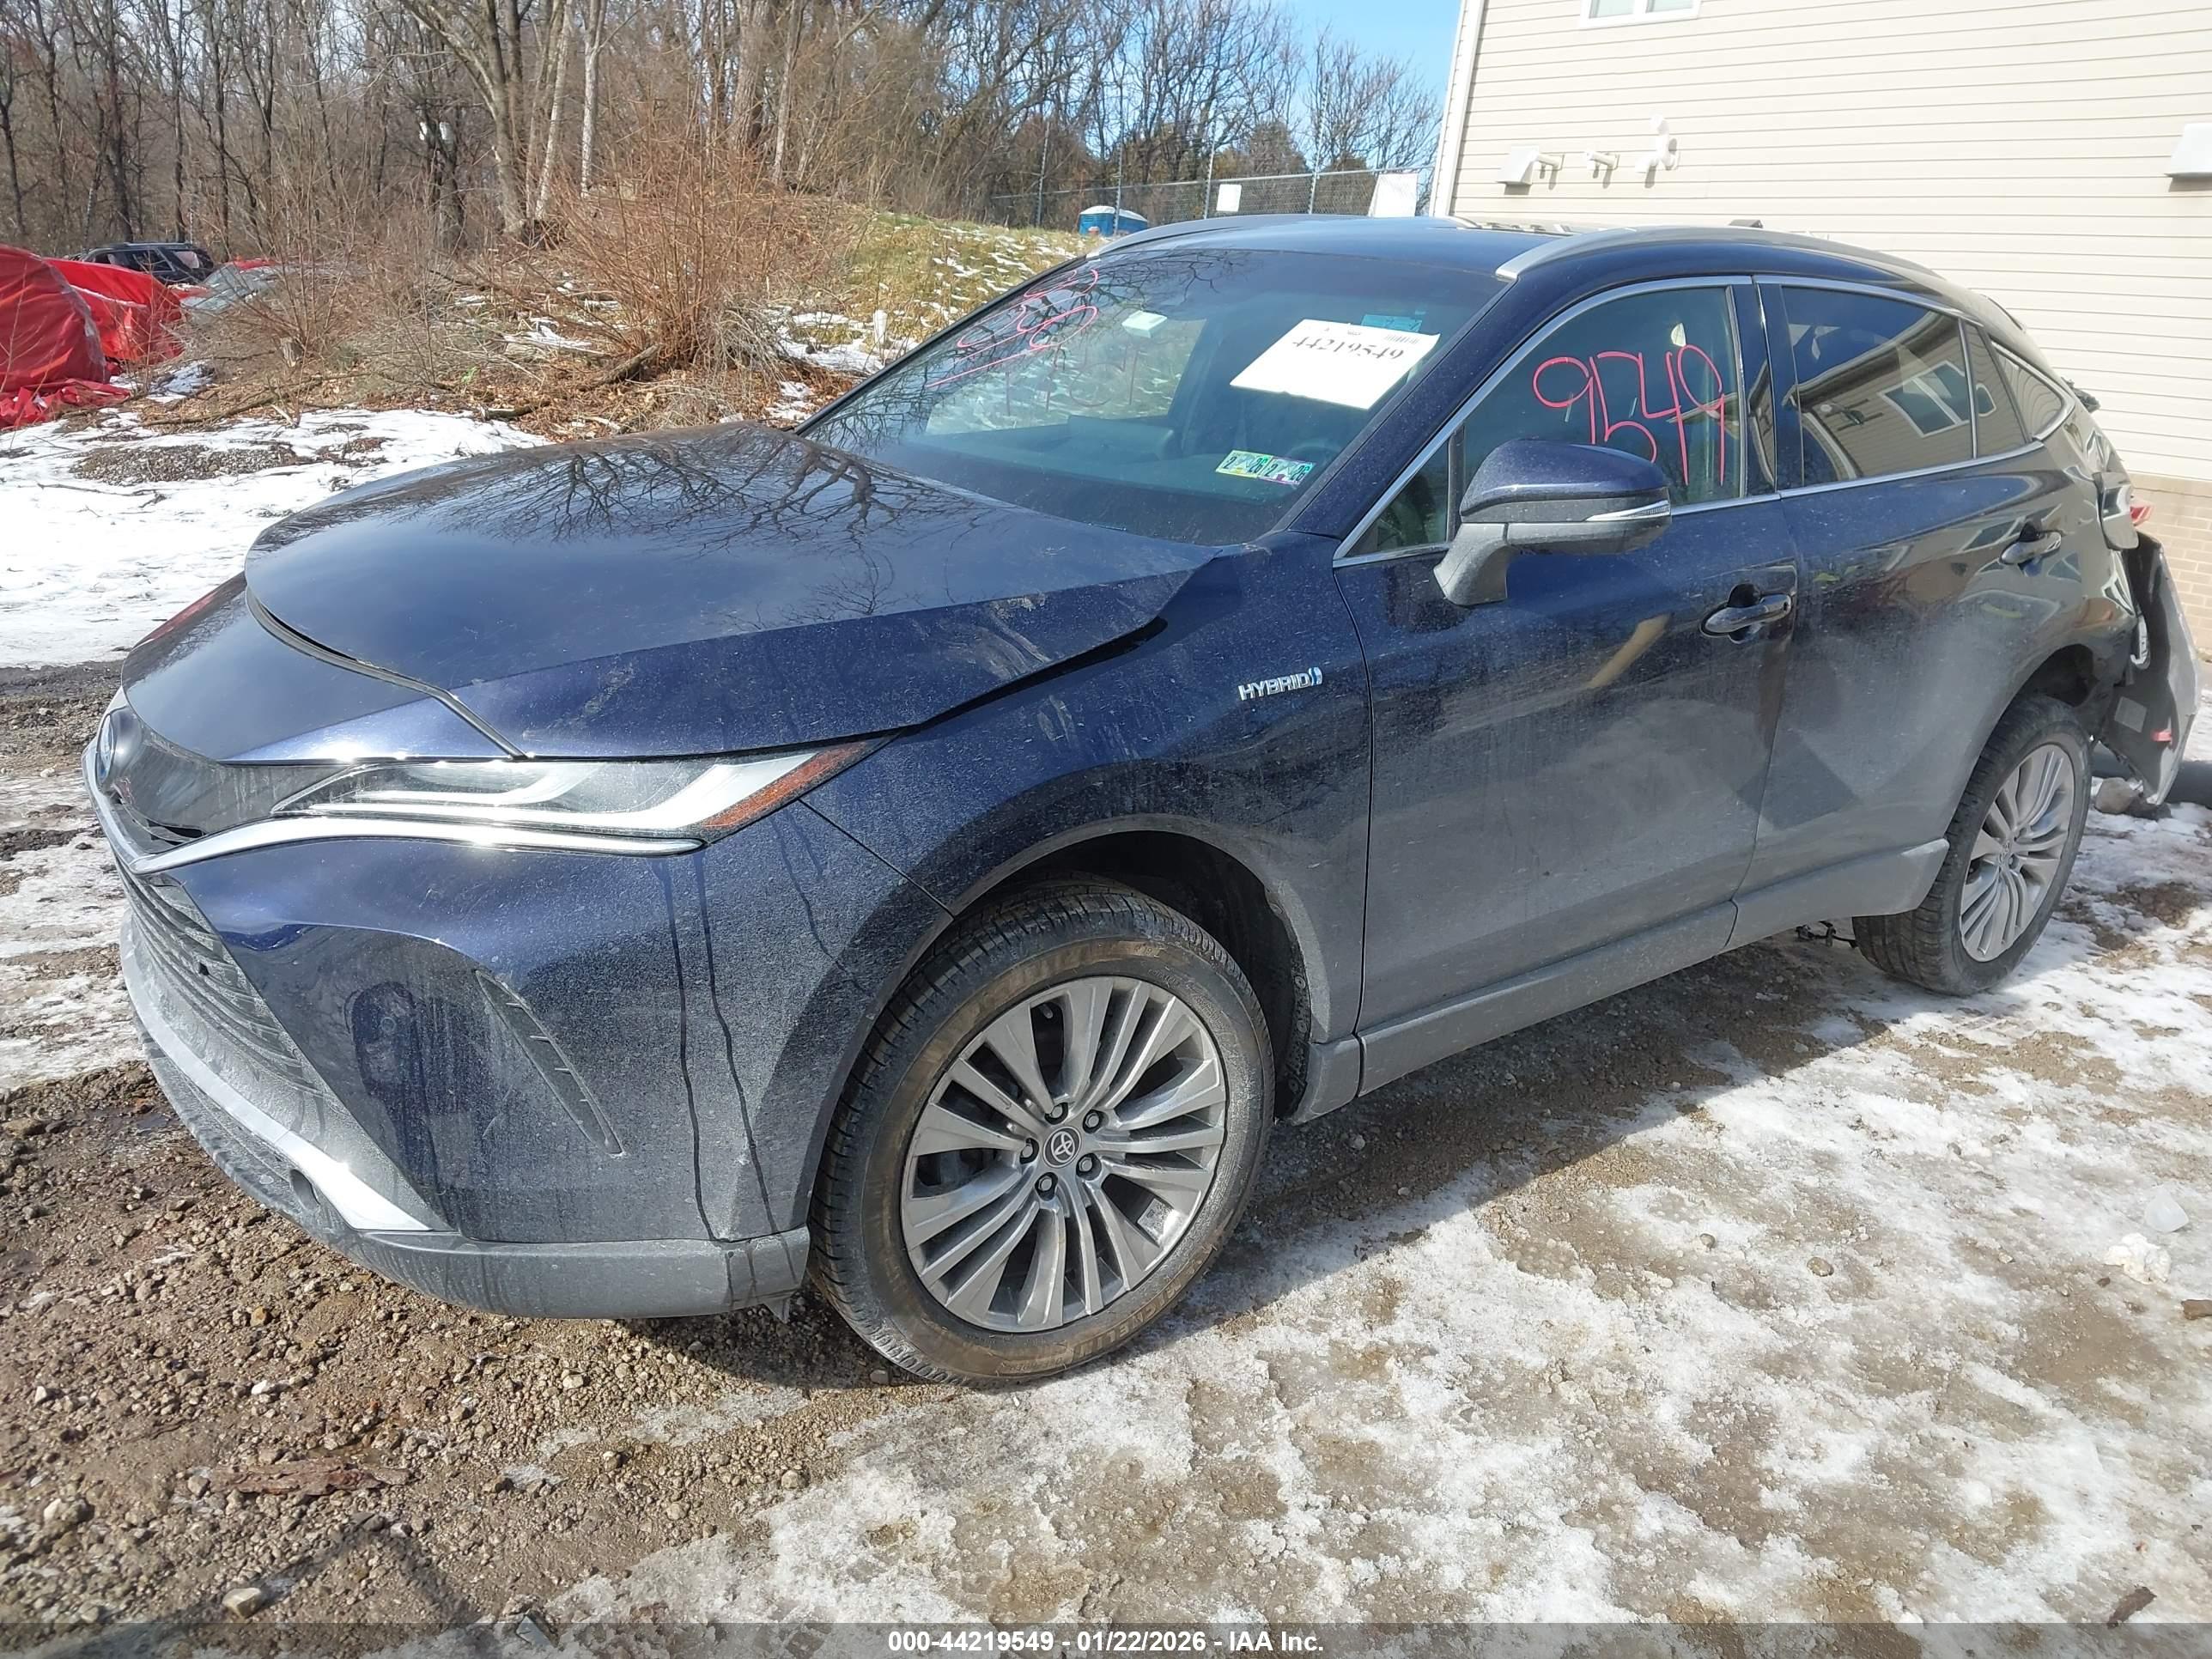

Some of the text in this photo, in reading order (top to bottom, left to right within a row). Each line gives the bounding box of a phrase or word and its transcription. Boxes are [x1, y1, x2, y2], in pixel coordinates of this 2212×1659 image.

[1292, 336, 1405, 360] 44219549
[1533, 344, 1726, 486] 9549
[1237, 672, 1311, 701] HYBRID
